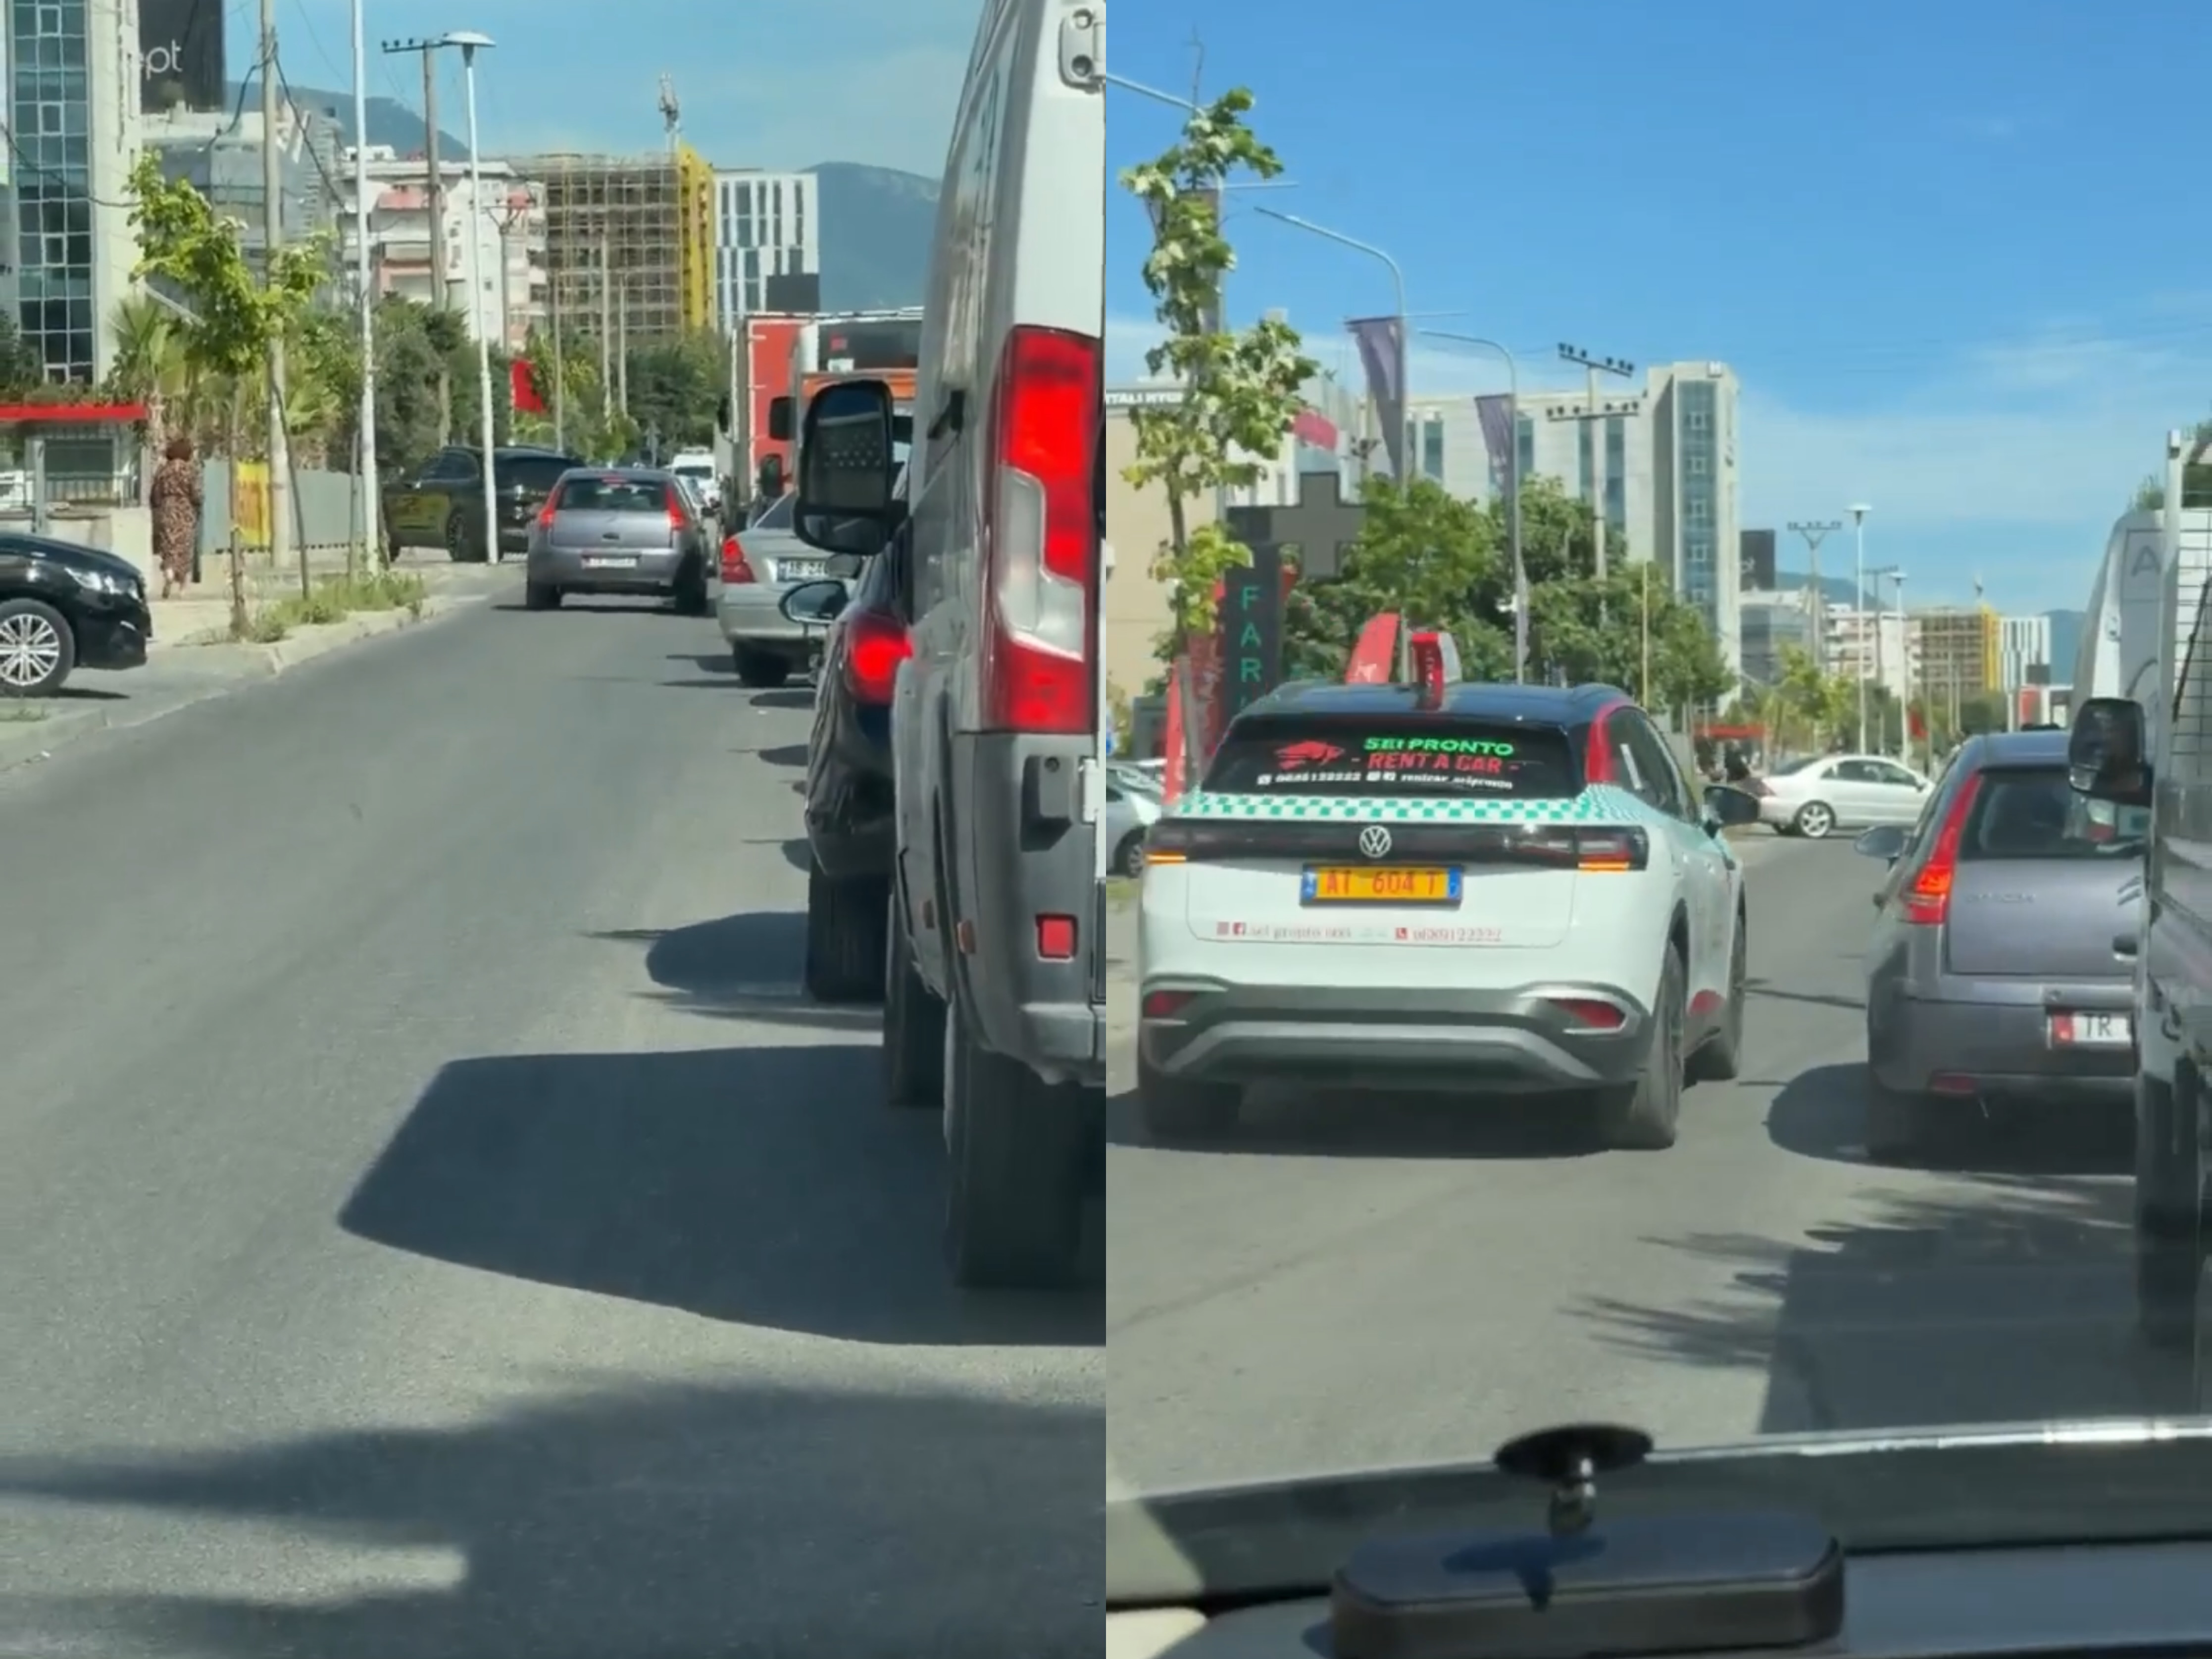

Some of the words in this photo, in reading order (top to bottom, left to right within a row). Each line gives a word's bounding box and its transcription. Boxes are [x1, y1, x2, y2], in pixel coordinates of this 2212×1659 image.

[140, 39, 183, 80] pt
[1364, 737, 1404, 750] SEI
[1407, 738, 1513, 756] PRONTO
[1367, 752, 1427, 769] RENT
[1432, 753, 1450, 769] A
[1455, 754, 1503, 774] CAR
